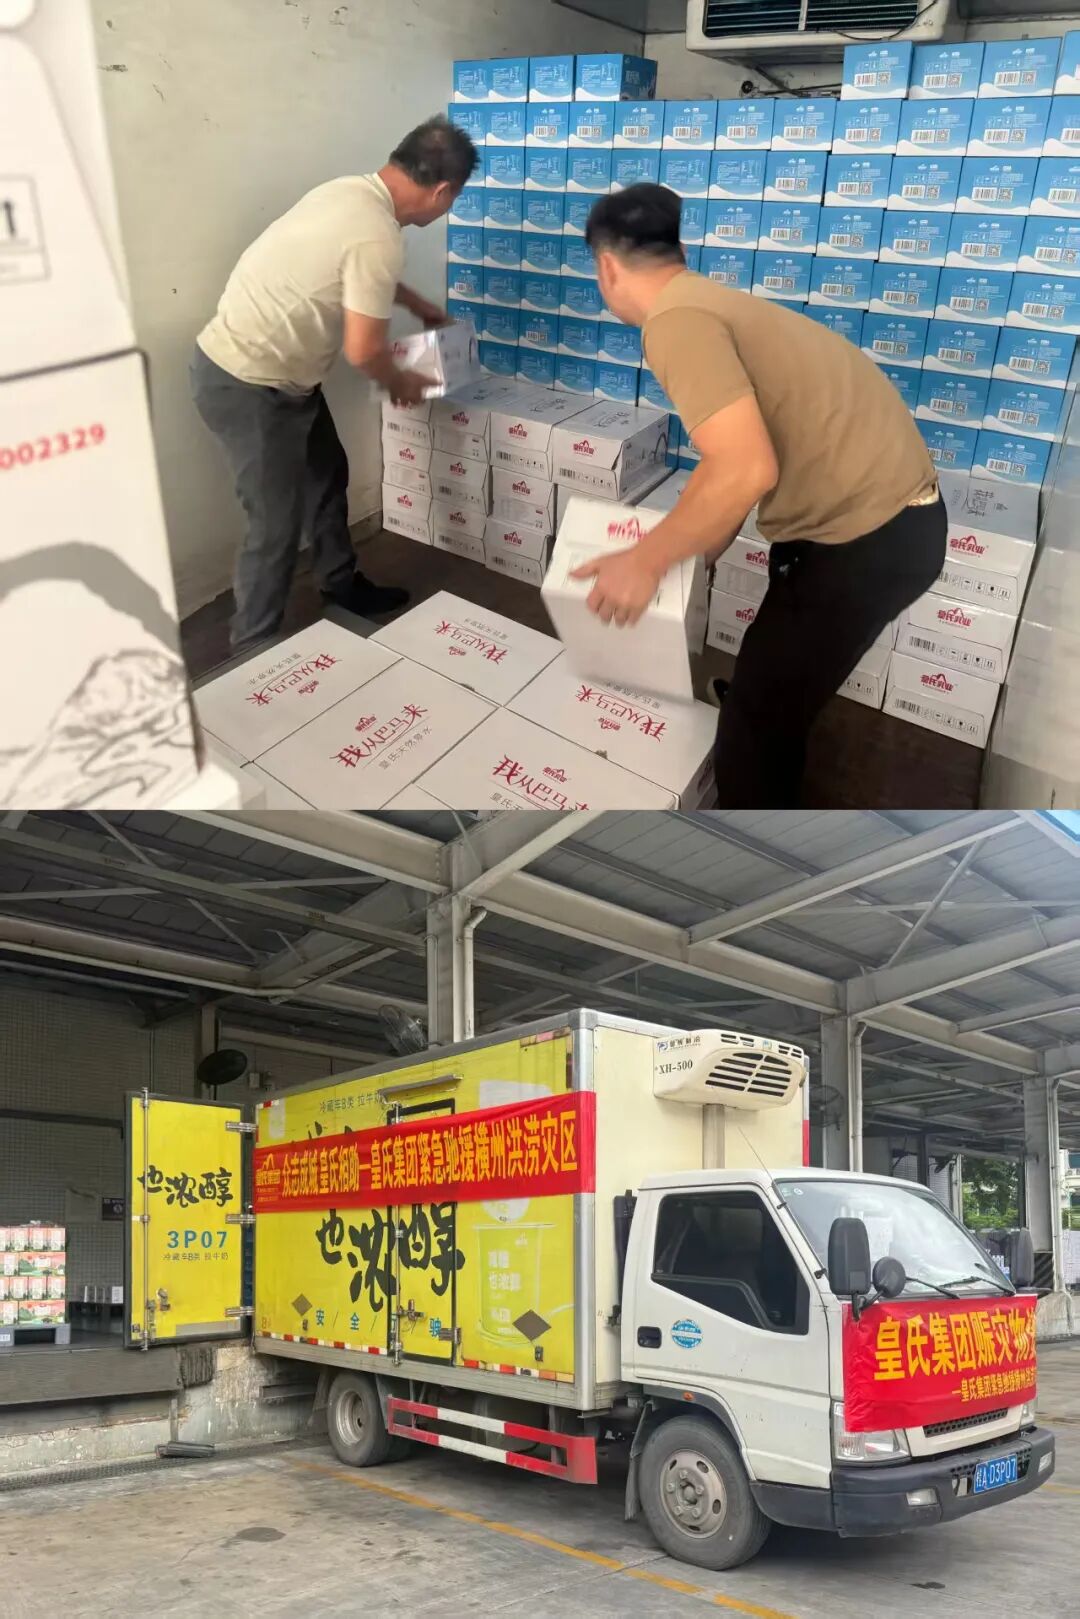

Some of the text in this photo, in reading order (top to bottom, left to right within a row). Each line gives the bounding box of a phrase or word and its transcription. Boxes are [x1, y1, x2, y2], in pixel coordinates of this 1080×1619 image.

[434, 620, 508, 665] 我从巴马来
[245, 653, 342, 707] 我从巴马来
[329, 703, 428, 768] 我从巴马来
[576, 684, 667, 742] 我从巴马来
[137, 1166, 234, 1208] 也浓醇
[167, 1229, 229, 1250] 3P07
